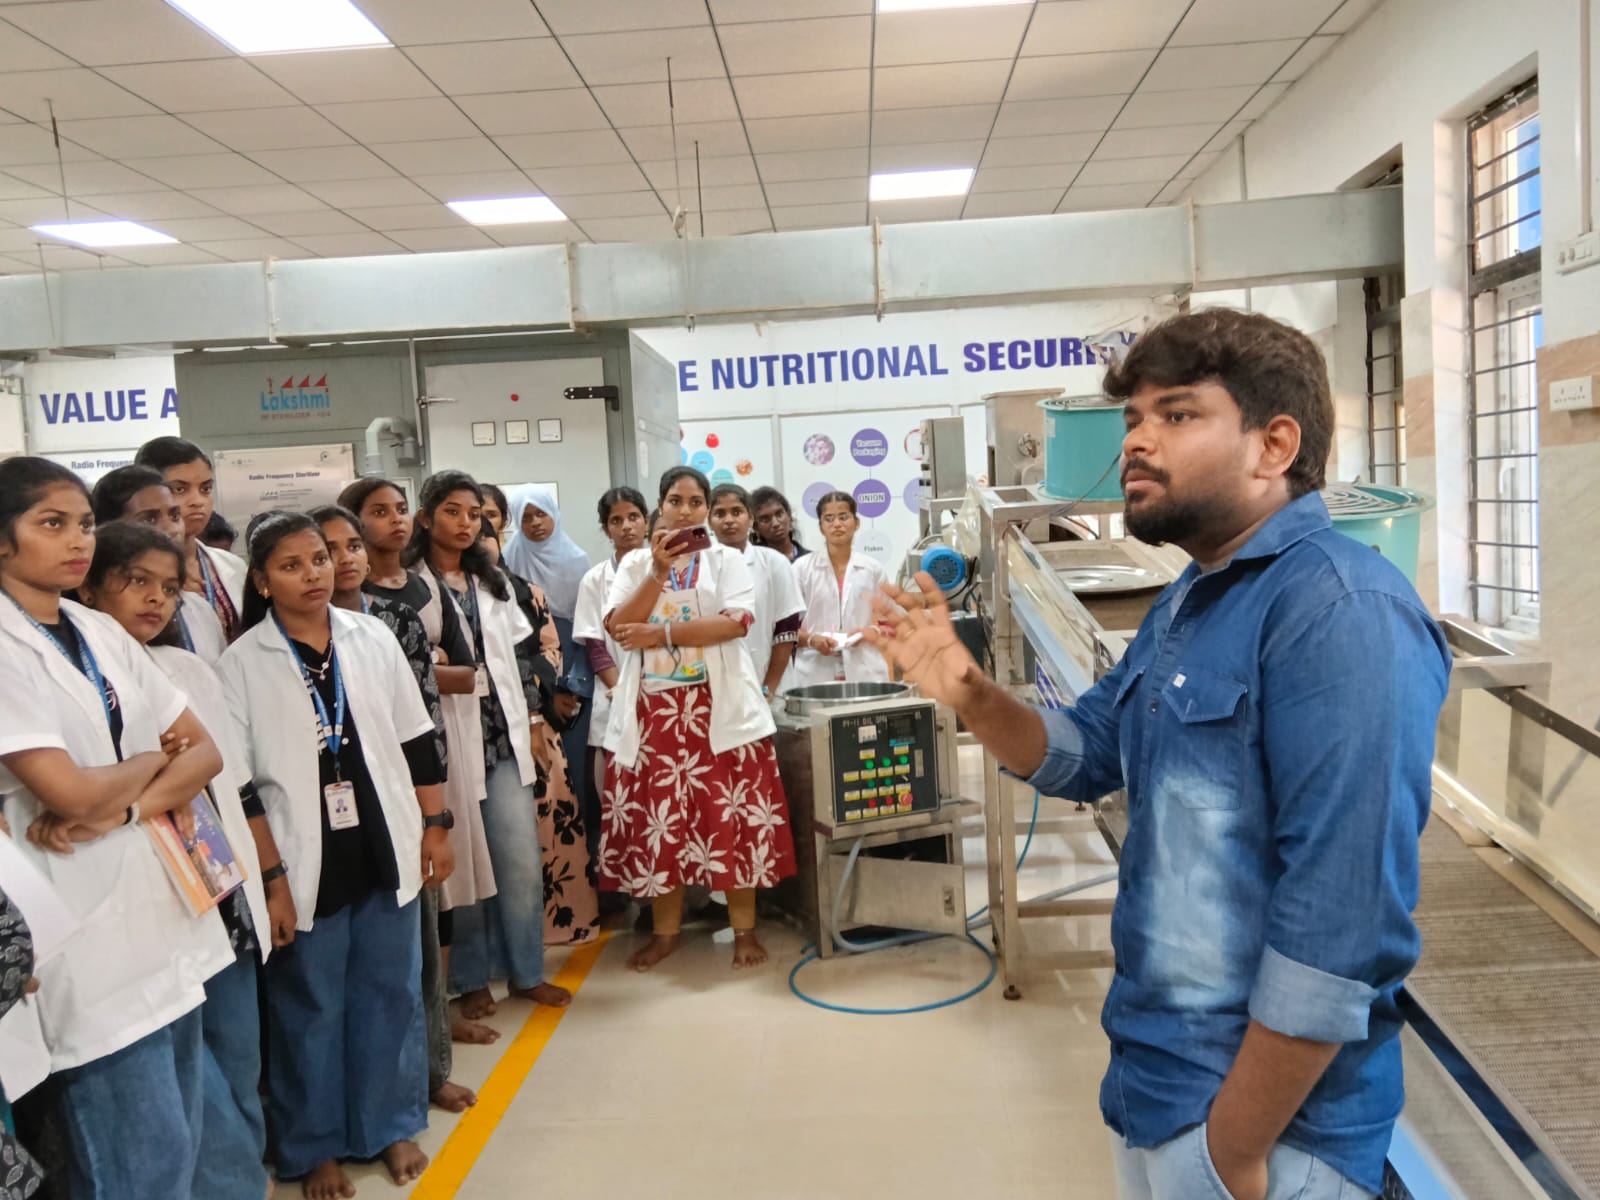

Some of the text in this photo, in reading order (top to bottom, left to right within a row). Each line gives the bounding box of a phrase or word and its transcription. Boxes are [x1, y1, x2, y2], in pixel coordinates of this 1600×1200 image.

[711, 343, 949, 390] NUTRITIONAL
[260, 388, 330, 412] Lakshmi
[39, 388, 149, 425] VALUE
[853, 448, 887, 457] Packaging
[71, 461, 95, 470] Radio
[859, 493, 886, 503] ONION
[863, 545, 885, 553] Flakes
